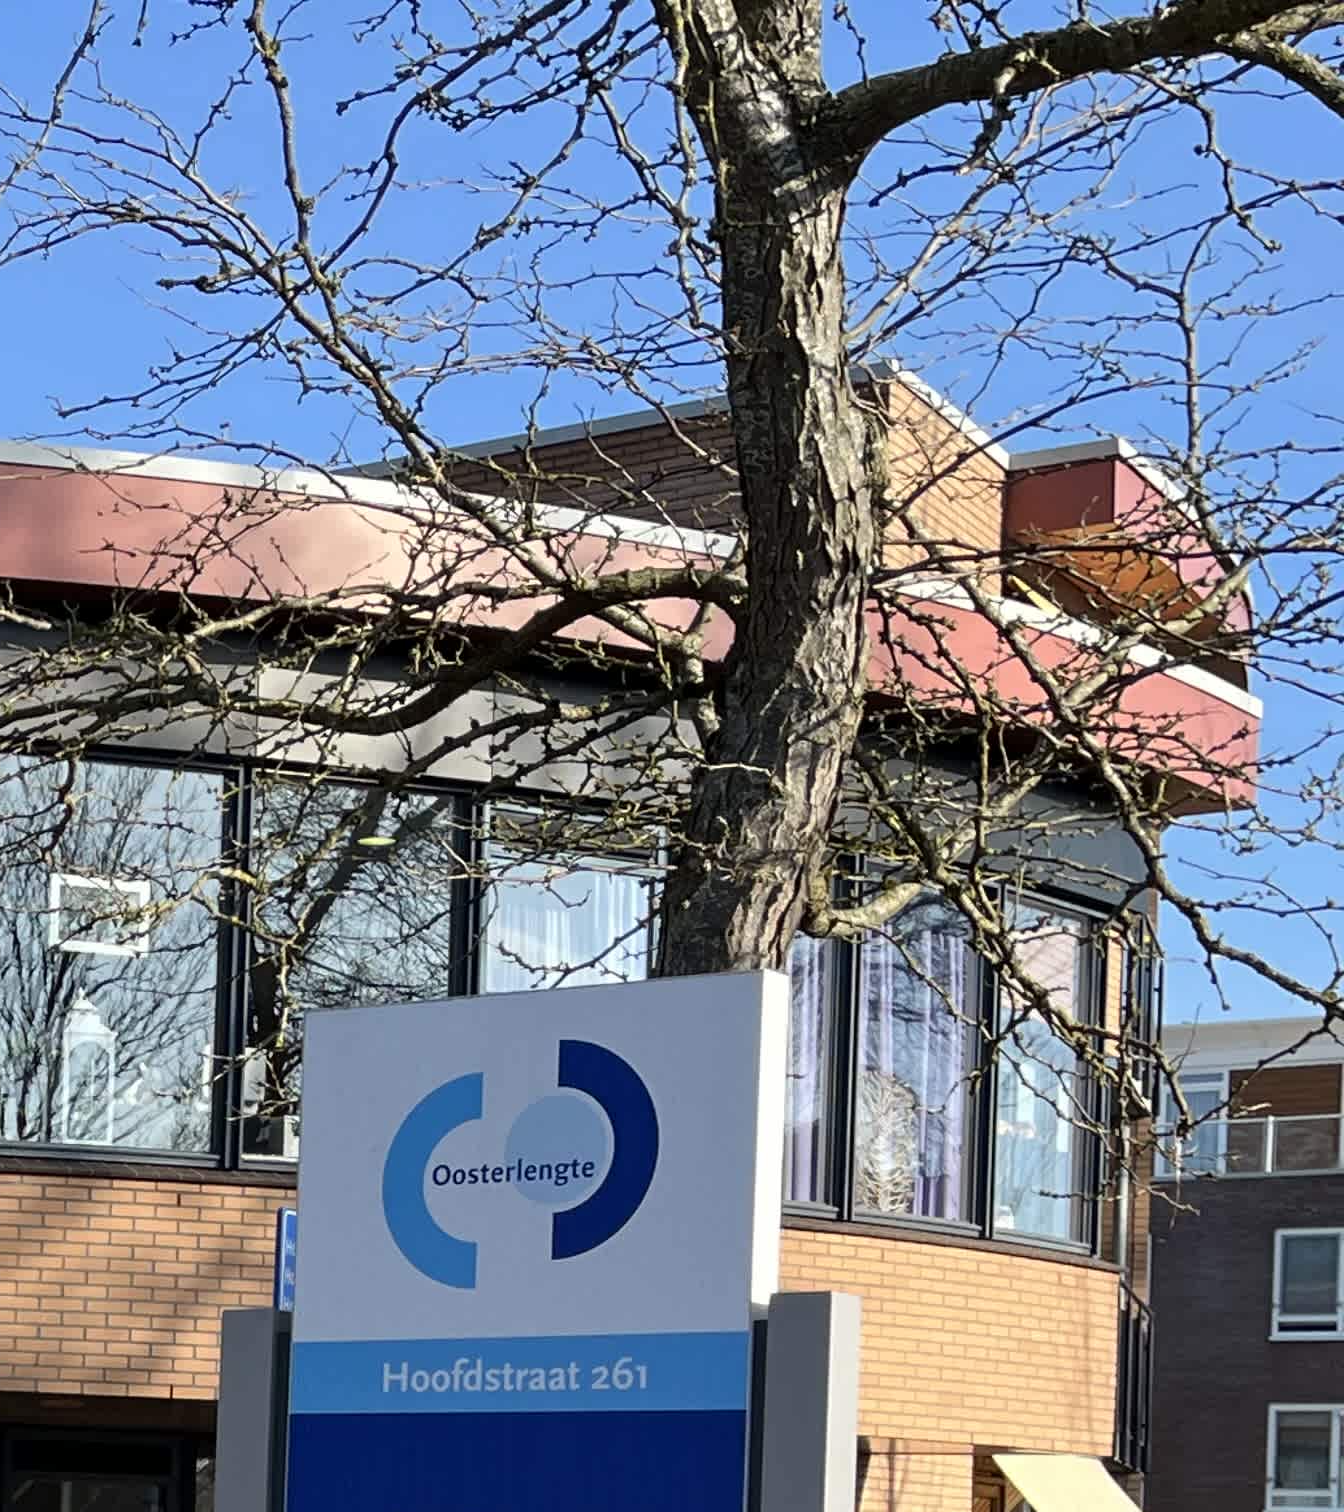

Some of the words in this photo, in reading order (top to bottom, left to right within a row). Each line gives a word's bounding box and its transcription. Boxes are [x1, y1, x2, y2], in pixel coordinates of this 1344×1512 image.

[431, 1157, 596, 1187] Oosterlengte
[381, 1356, 582, 1393] Hoofdstraat
[591, 1356, 649, 1391] 261
